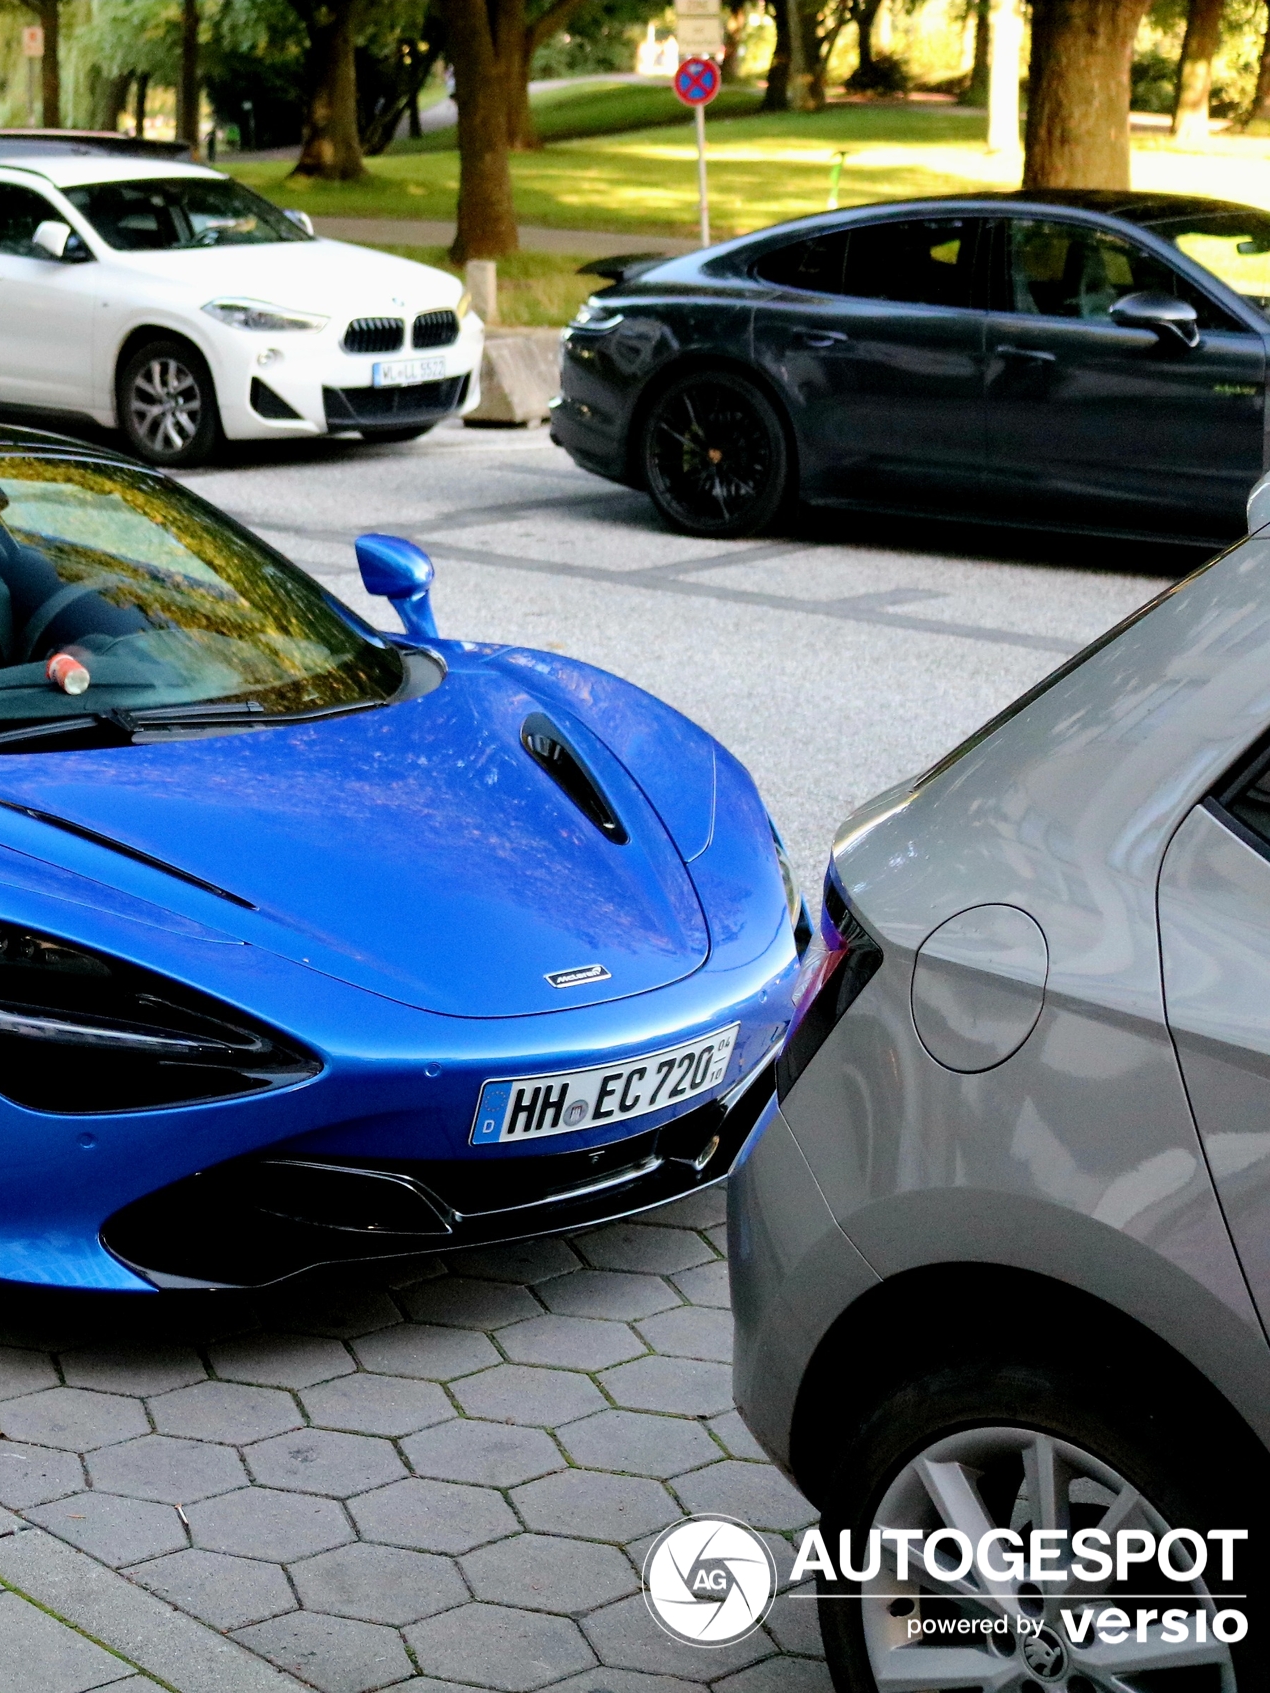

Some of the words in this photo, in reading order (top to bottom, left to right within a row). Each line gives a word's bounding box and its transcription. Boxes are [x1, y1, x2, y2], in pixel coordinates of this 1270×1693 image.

[556, 969, 601, 983] McLaren
[710, 1067, 723, 1083] 10
[482, 1119, 495, 1133] D
[507, 1082, 570, 1135] HH
[591, 1066, 646, 1121] EC
[649, 1045, 715, 1106] 720
